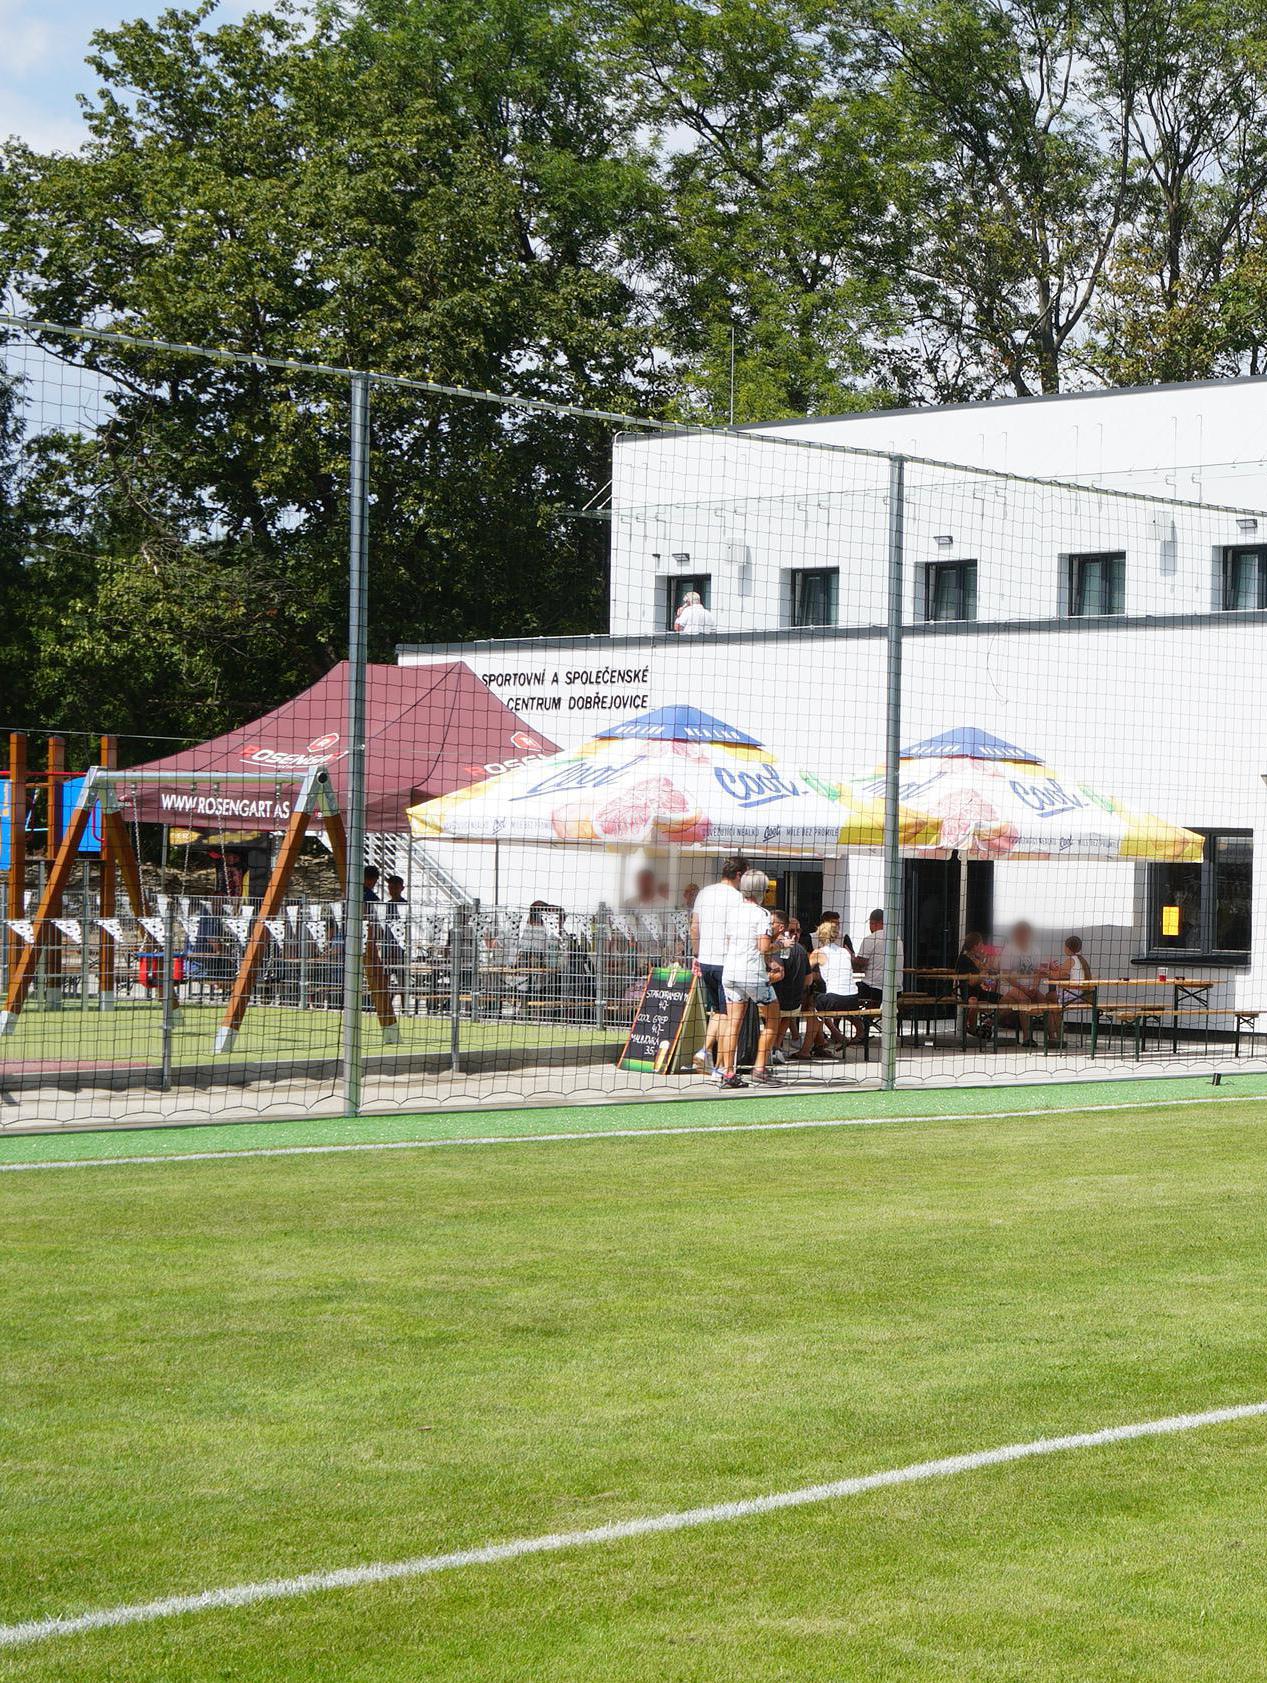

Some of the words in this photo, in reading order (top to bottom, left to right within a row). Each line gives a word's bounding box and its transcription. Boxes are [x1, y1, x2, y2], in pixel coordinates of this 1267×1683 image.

[481, 668, 546, 687] SPORTOVNÍ
[551, 676, 559, 685] A
[565, 665, 649, 685] SPOLEČENSKÉ
[507, 697, 561, 711] CENTRUM
[568, 692, 649, 710] DOBŘEJOVICE
